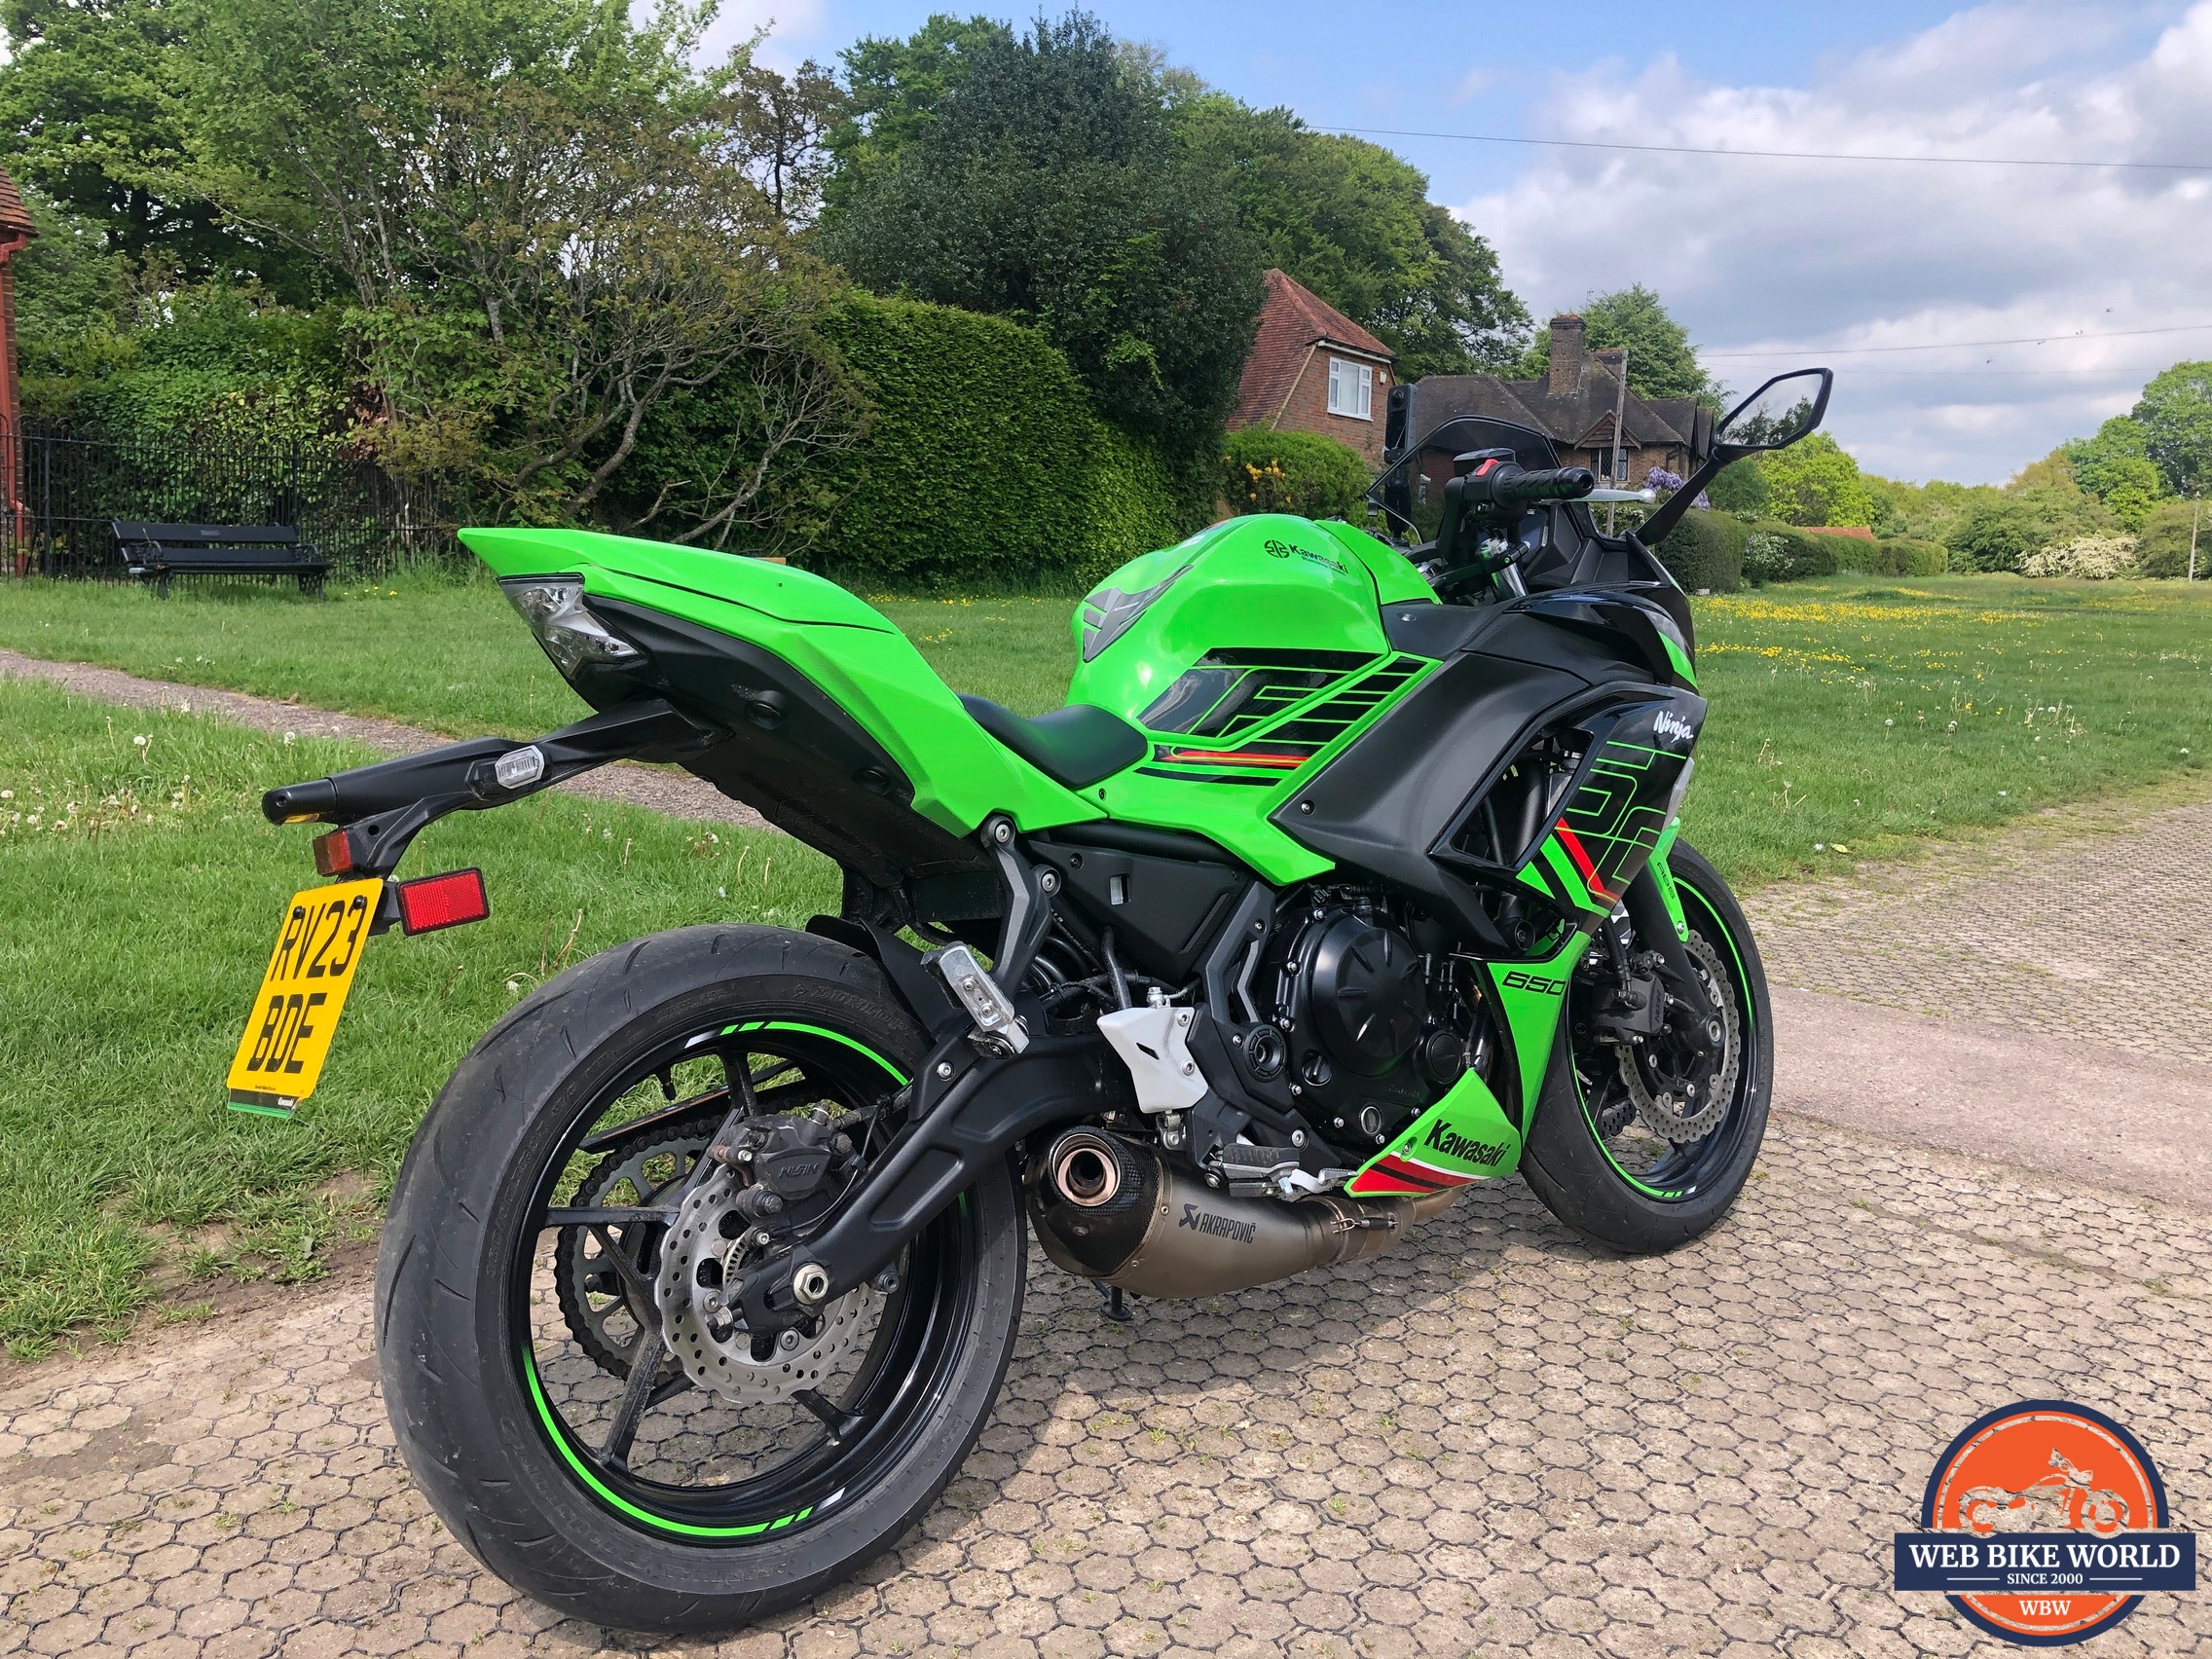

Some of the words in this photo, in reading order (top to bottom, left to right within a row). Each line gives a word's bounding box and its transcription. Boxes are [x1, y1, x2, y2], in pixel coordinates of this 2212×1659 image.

[1288, 543, 1349, 574] Kawasaki
[1653, 710, 1694, 743] Ninja
[1656, 861, 1676, 900] ABS
[269, 895, 368, 982] RV23
[1501, 970, 1567, 996] 650
[246, 992, 327, 1074] BDE
[1423, 1119, 1512, 1167] Kawasaki
[1198, 1212, 1257, 1244] AKRAPOVIČ
